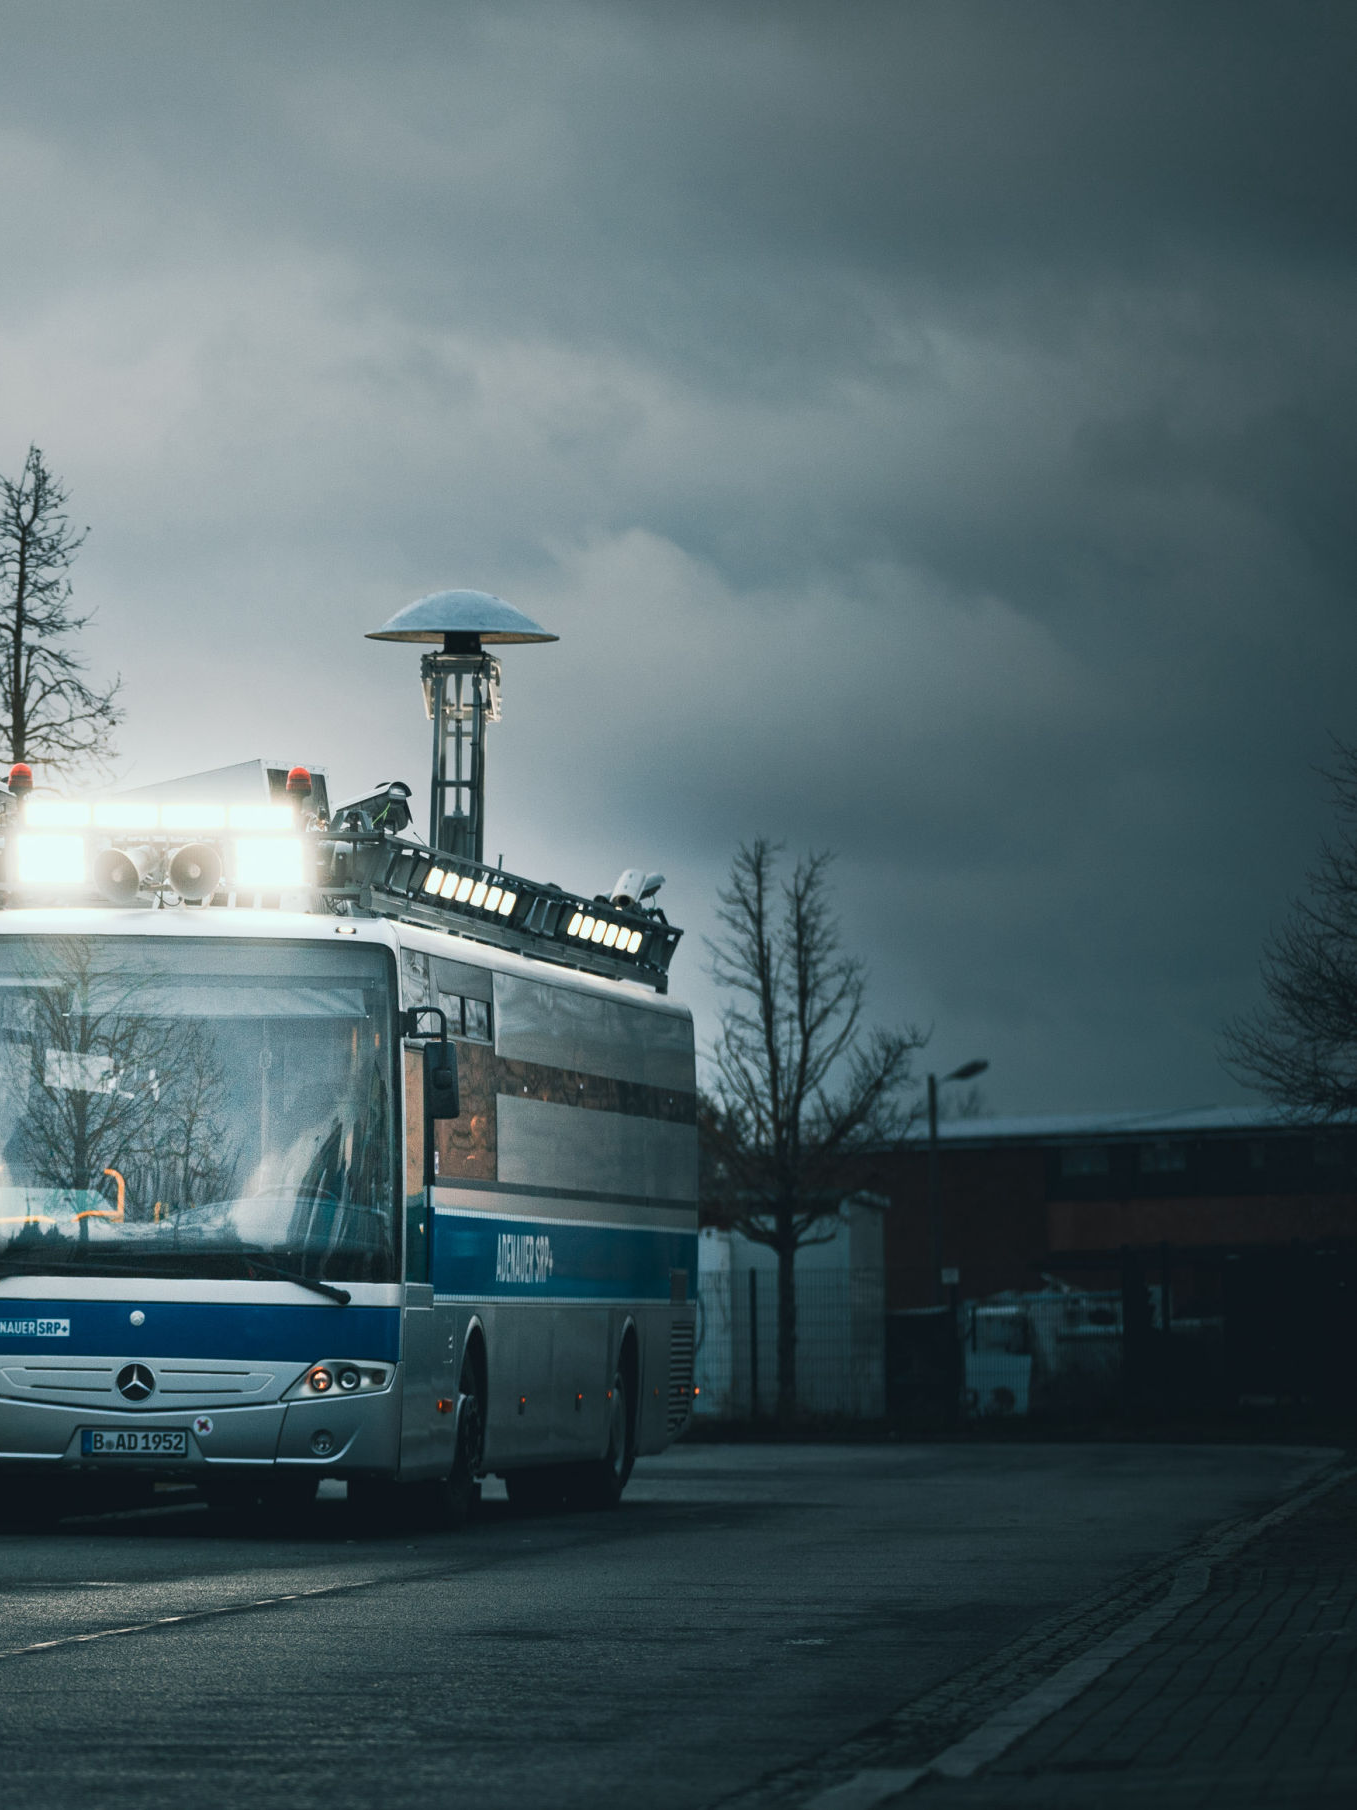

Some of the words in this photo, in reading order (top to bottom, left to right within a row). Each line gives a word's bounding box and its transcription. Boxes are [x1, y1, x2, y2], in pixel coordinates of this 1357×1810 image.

[496, 1232, 534, 1283] ADENAUER
[38, 1321, 68, 1335] SRP+
[93, 1433, 104, 1450] B
[115, 1433, 138, 1450] AD
[141, 1434, 184, 1451] 1952
